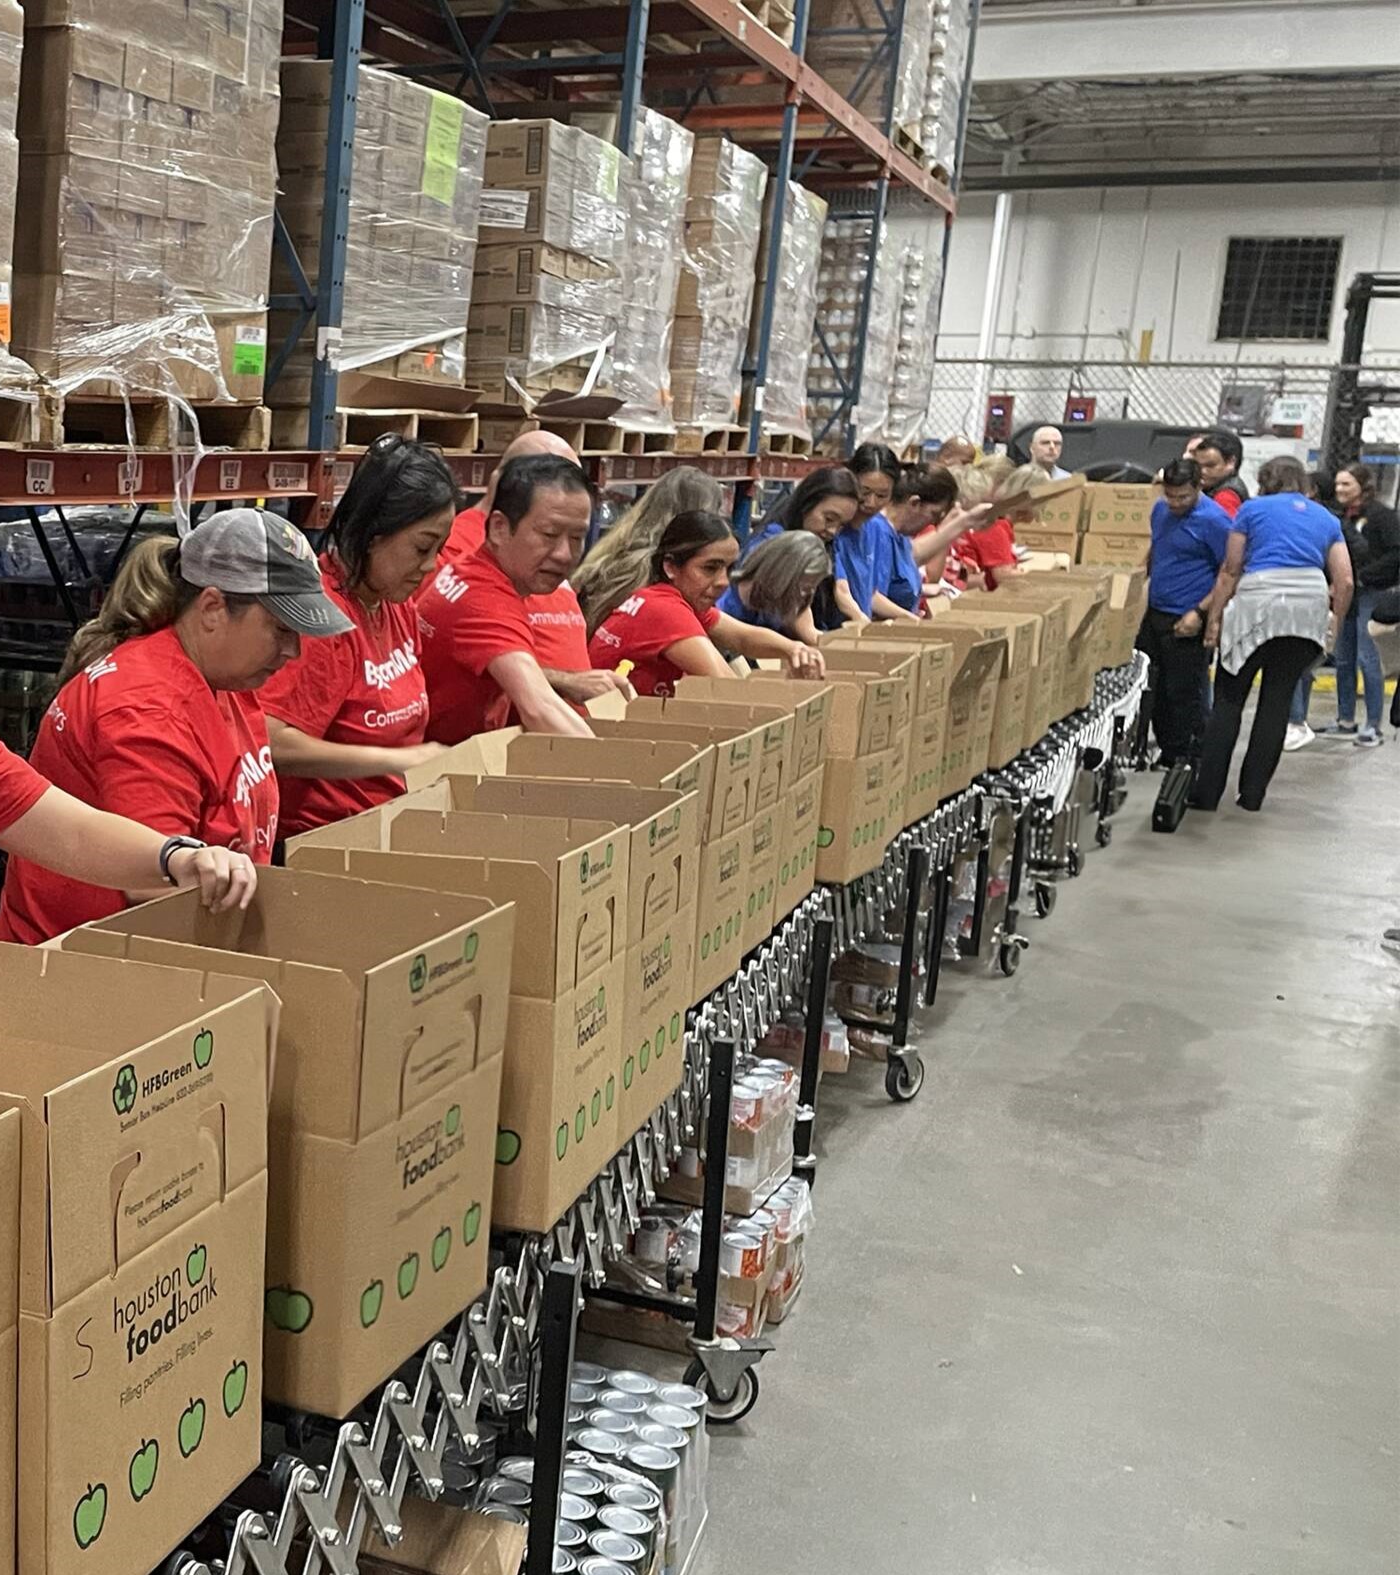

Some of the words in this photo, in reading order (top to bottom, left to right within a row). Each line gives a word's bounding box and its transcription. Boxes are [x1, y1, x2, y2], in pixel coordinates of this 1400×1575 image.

[33, 480, 46, 492] CC
[225, 478, 235, 489] EE
[142, 1062, 192, 1098] HFBGreen
[402, 1123, 465, 1190] foodbank
[113, 1267, 181, 1334] houston
[126, 1266, 218, 1364] foodbank
